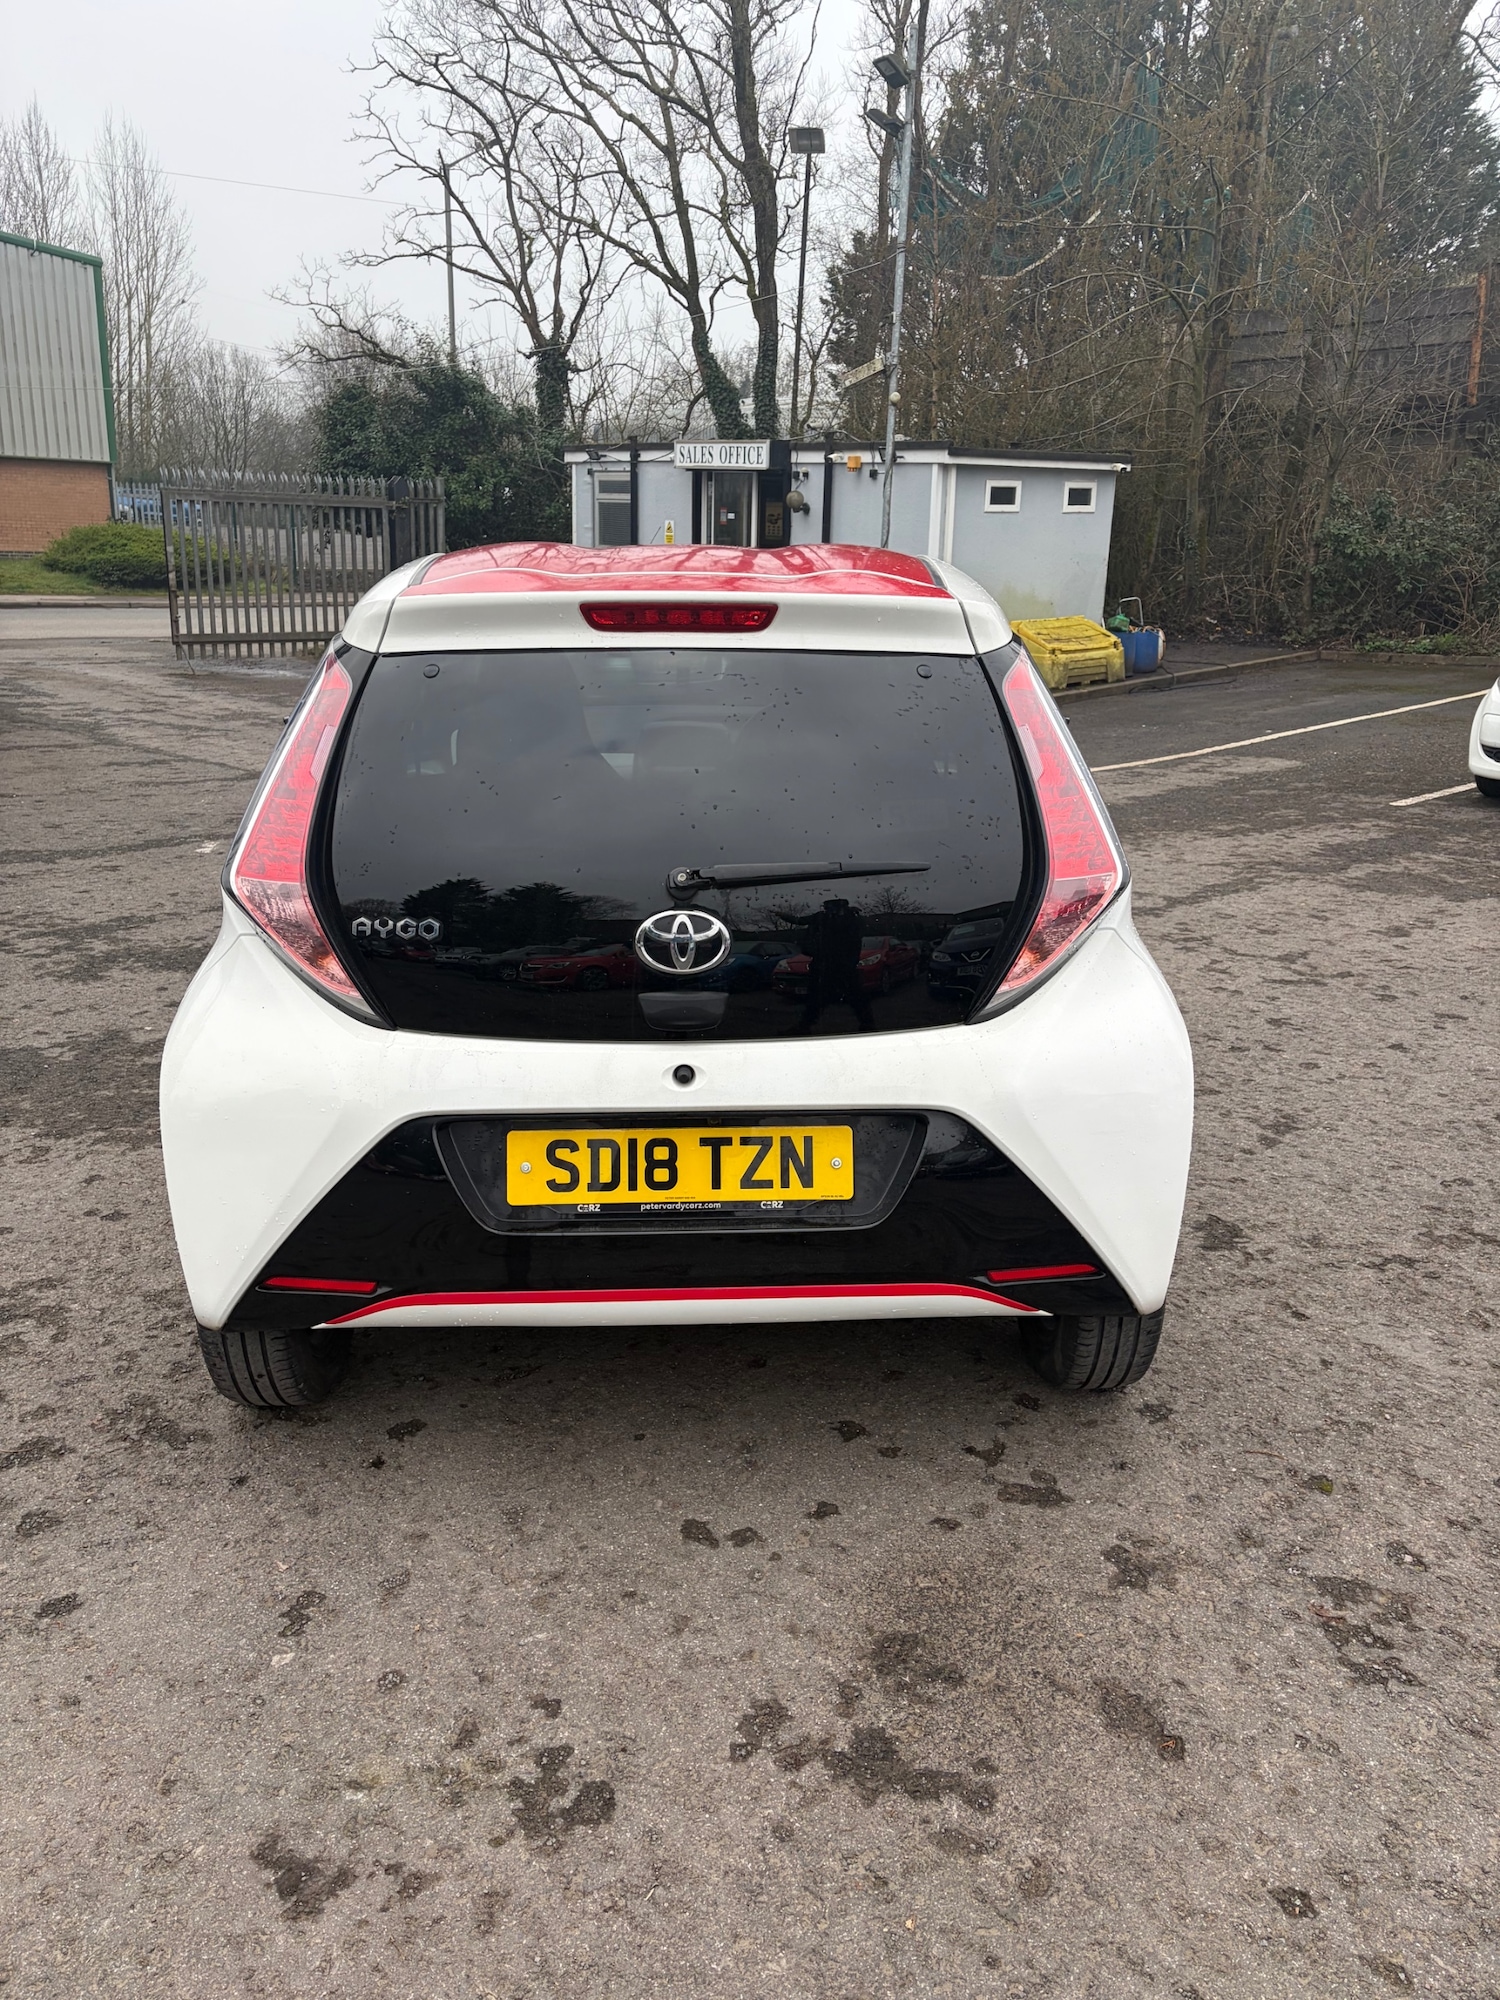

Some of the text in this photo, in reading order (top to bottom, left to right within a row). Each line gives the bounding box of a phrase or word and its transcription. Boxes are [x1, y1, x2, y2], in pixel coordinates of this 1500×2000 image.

[679, 445, 764, 465] SALES OFFICE
[352, 916, 440, 940] AYGO
[545, 1135, 814, 1193] SD18 TZN
[640, 1201, 721, 1212] petervardycarz.com
